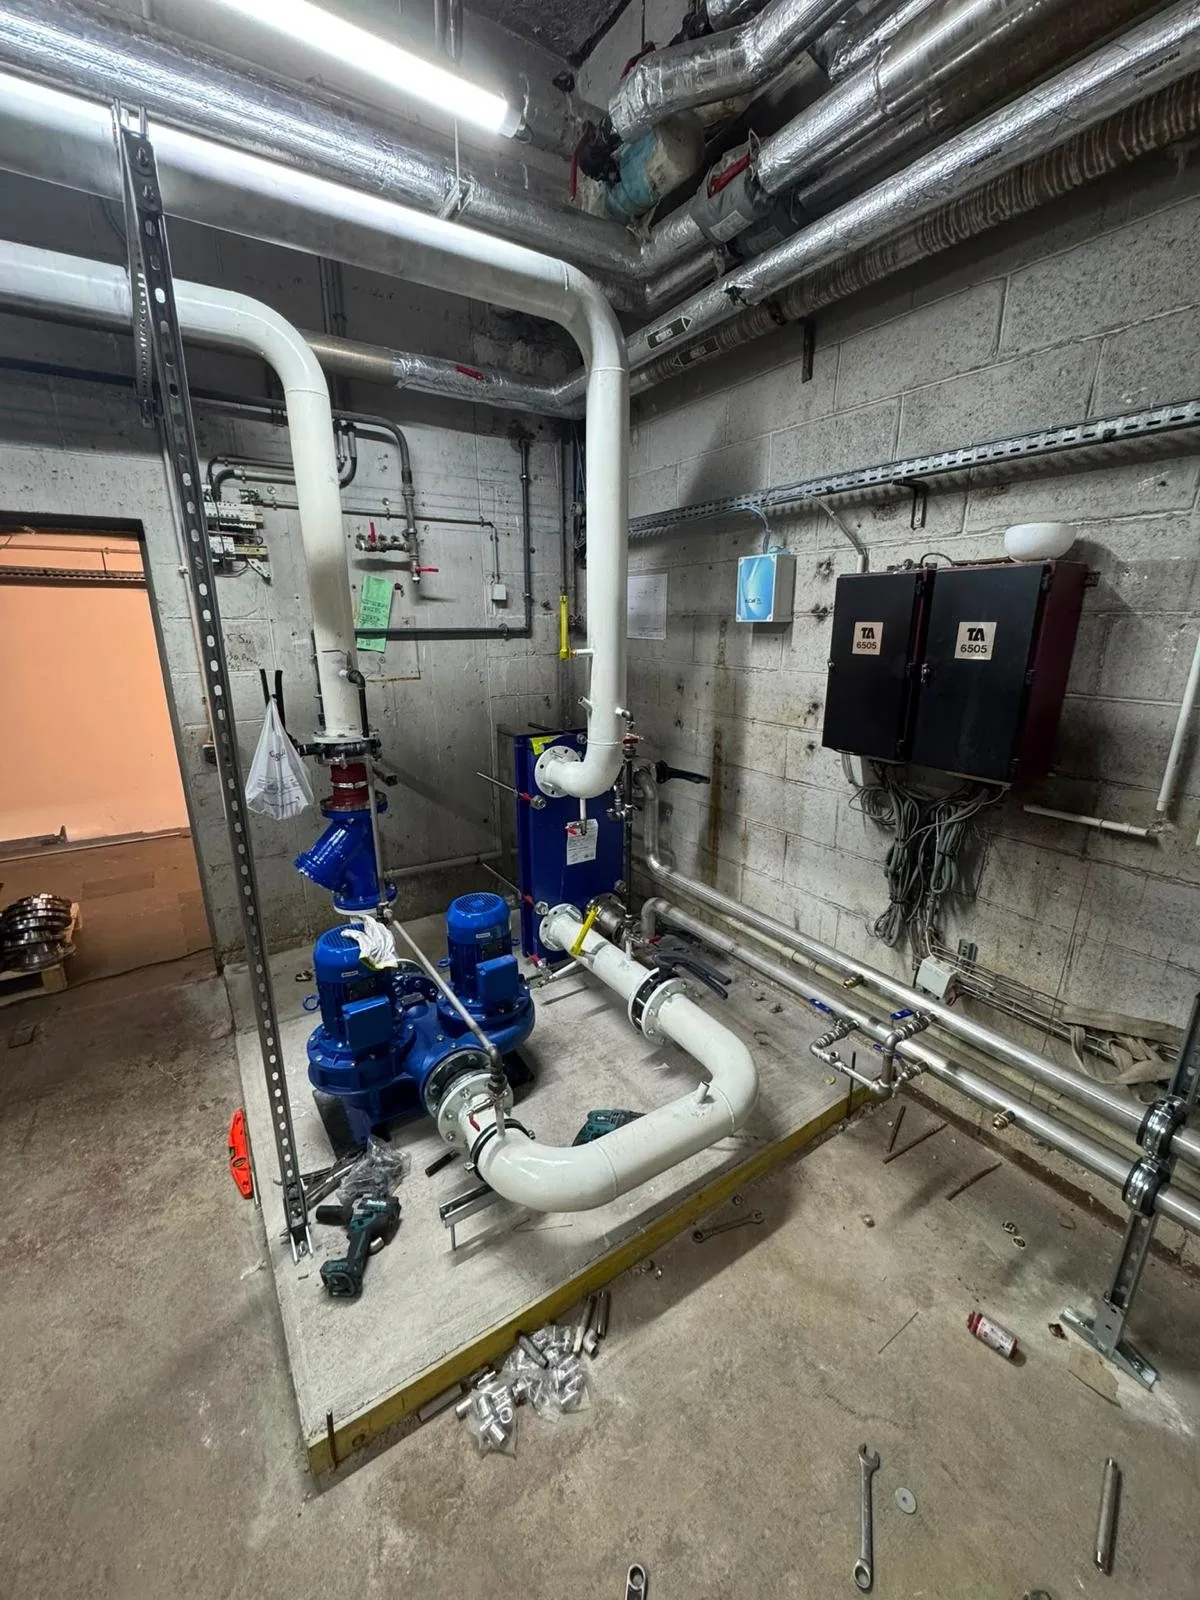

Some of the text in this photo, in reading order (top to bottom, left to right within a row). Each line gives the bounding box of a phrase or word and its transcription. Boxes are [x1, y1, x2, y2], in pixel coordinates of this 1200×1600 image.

[861, 627, 875, 639] TA
[967, 627, 985, 641] TA
[856, 641, 877, 650] 6505
[960, 644, 987, 653] 6505
